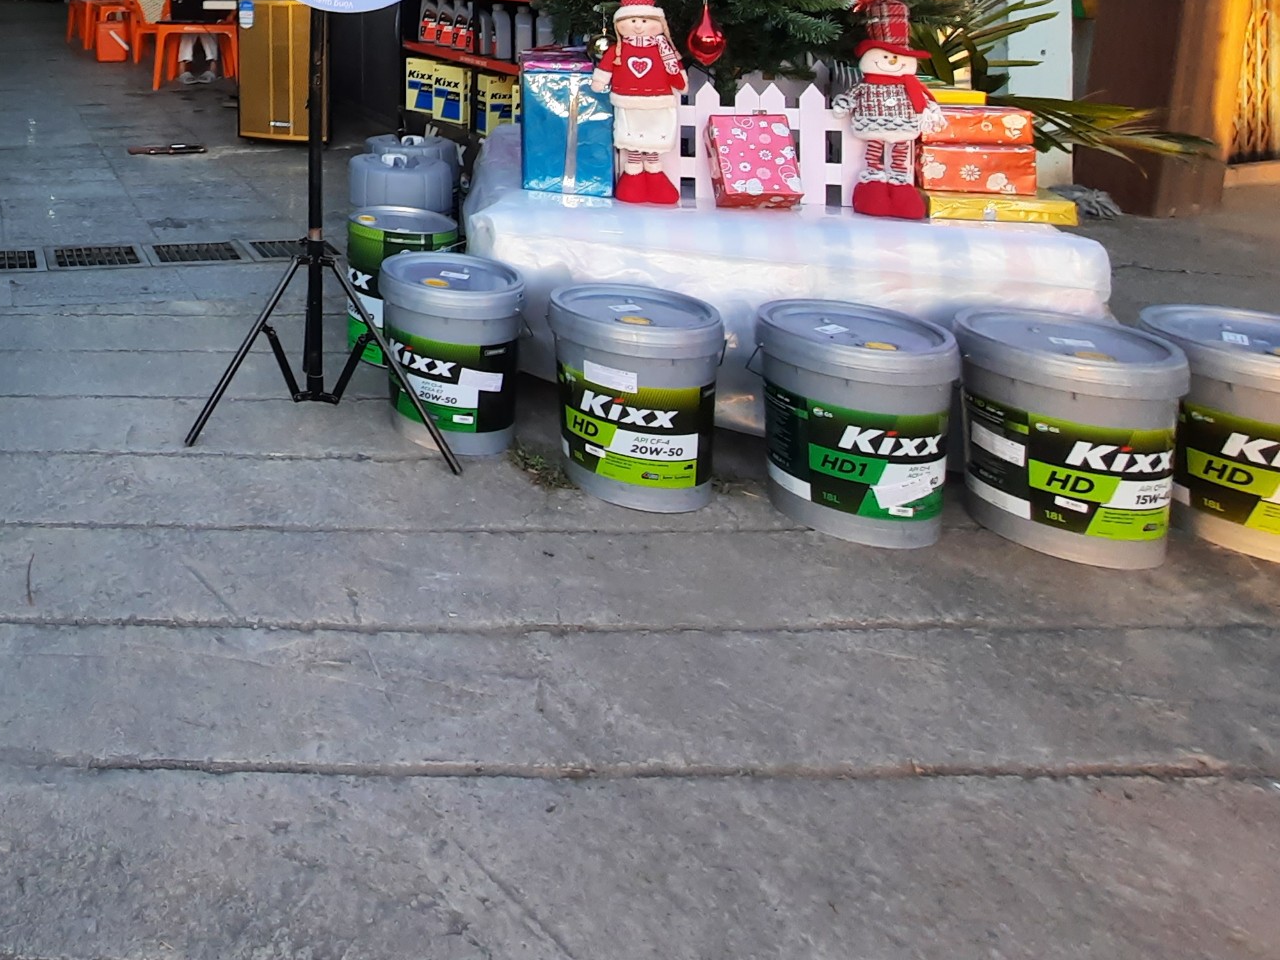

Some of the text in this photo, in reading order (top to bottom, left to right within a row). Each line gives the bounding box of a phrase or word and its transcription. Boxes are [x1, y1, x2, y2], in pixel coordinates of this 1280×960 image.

[408, 69, 433, 81] Kixx
[434, 77, 460, 89] Kixx
[490, 92, 513, 100] Kixx
[348, 265, 374, 290] xx
[389, 338, 457, 378] Kixx
[419, 390, 458, 404] 20W-50
[580, 389, 679, 429] Kixx
[573, 415, 599, 437] HD
[633, 436, 648, 444] API
[838, 425, 943, 457] Kixx
[630, 444, 684, 457] 20W-50
[1065, 440, 1173, 474] Kixx
[821, 454, 869, 477] HD1
[1202, 460, 1254, 486] HD
[1045, 471, 1095, 494] HD
[822, 491, 840, 504] 18L
[1203, 498, 1225, 512] 18L
[1044, 509, 1067, 523] 18L
